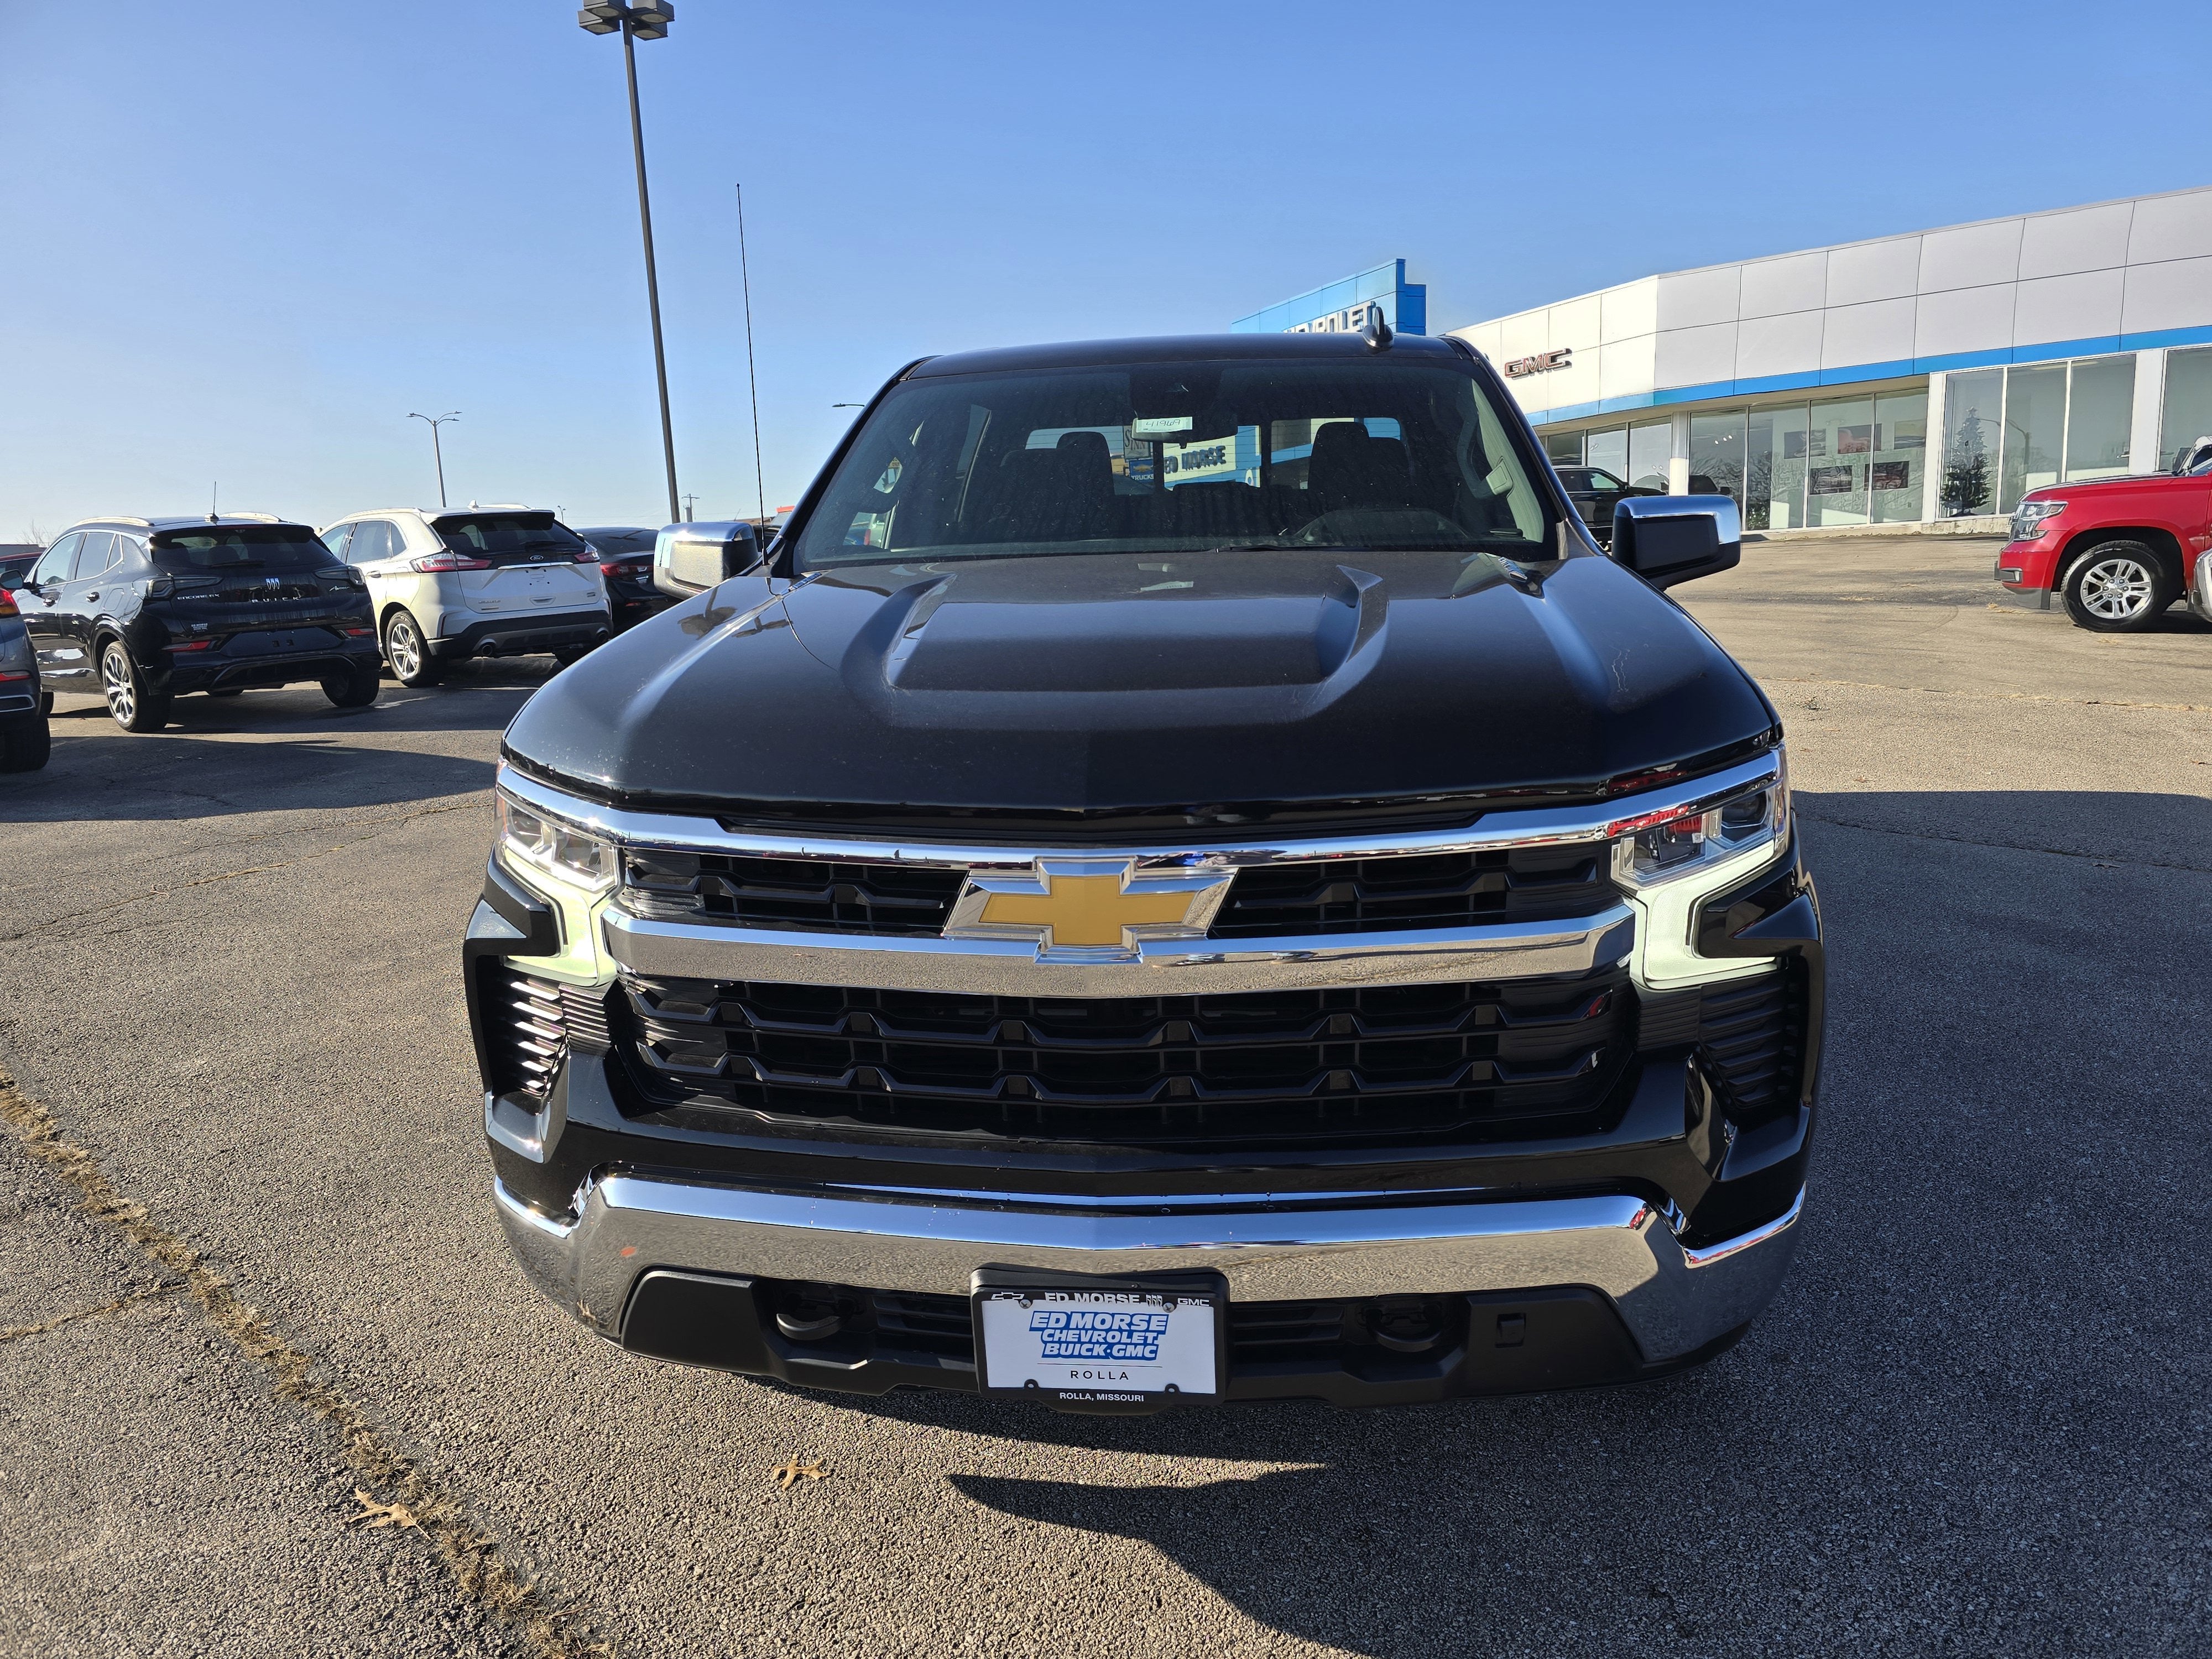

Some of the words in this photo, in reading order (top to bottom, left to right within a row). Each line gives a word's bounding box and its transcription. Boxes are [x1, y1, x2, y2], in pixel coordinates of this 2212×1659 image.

[1505, 348, 1572, 378] GMC
[1045, 1292, 1069, 1302] ED
[1074, 1293, 1140, 1304] MORSE
[1177, 1298, 1209, 1307] GMC
[1031, 1312, 1067, 1328] ED
[1070, 1313, 1167, 1331] MORSE
[1042, 1329, 1157, 1344] CHEVROLET
[1071, 1370, 1129, 1380] ROLLA
[1060, 1392, 1094, 1401] ROLLA,
[1097, 1393, 1144, 1402] MISSOURI
